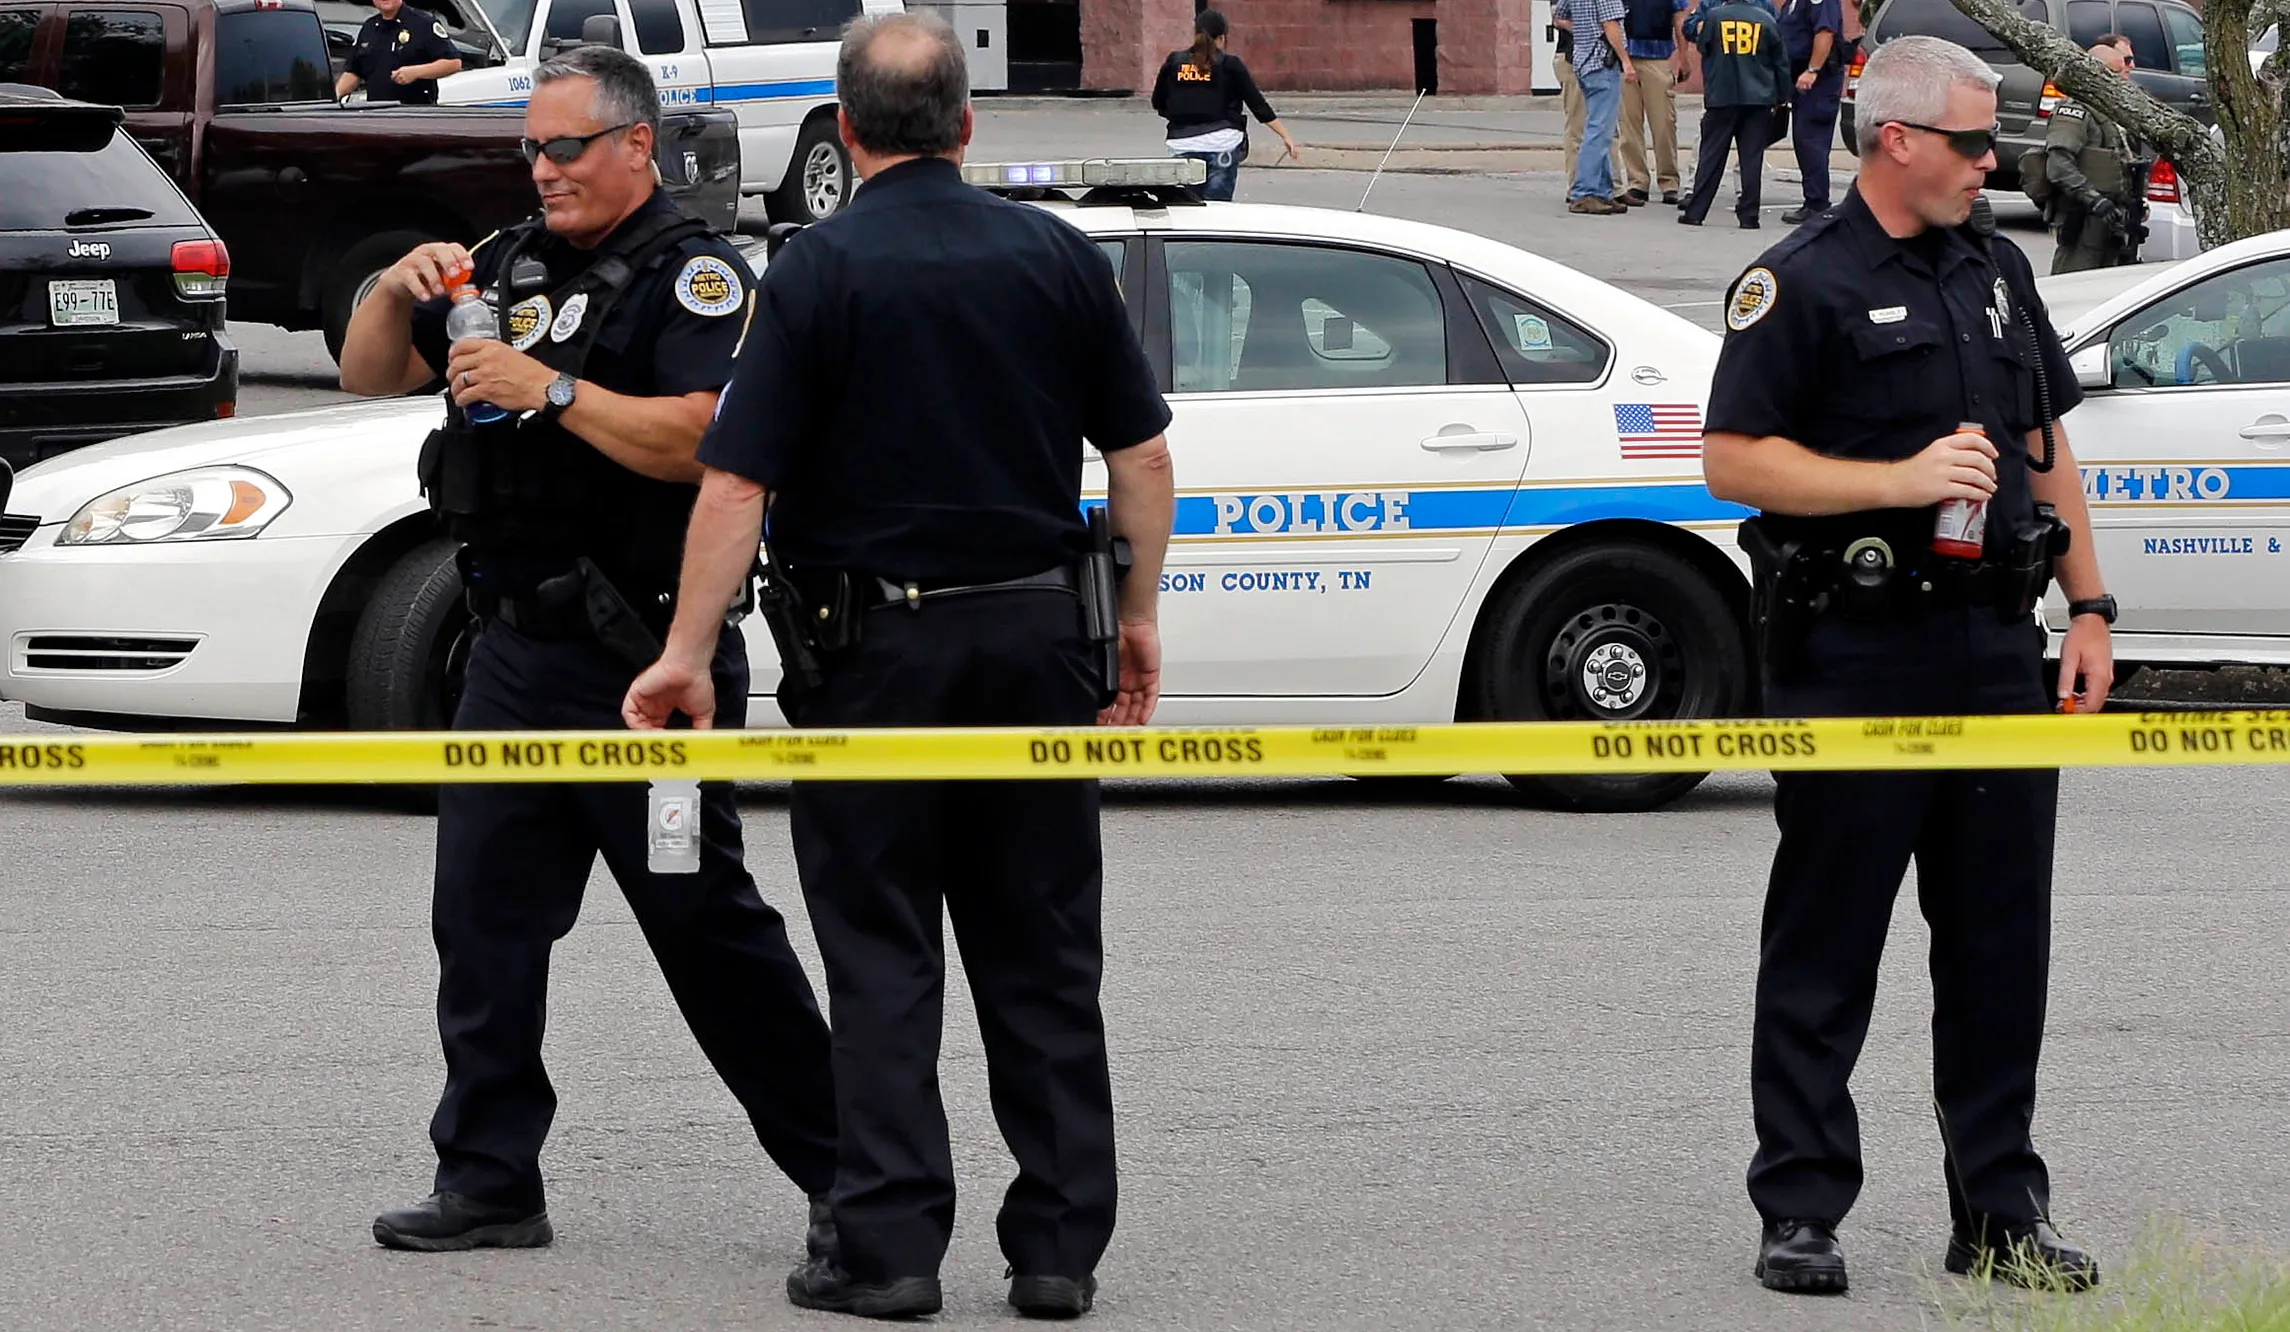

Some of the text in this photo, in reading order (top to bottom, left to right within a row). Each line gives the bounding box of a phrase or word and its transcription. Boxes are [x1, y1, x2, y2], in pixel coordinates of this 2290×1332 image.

[1720, 20, 1763, 55] FBI
[508, 76, 531, 91] 1062
[660, 65, 678, 79] K-9
[1177, 72, 1211, 81] POLICE
[658, 88, 697, 106] OLICE
[2058, 107, 2086, 119] POLICE
[68, 239, 111, 261] Jeep
[691, 281, 729, 294] POLICE
[2080, 467, 2230, 501] METRO
[1213, 492, 1410, 534] POLICE
[2144, 537, 2281, 554] NASHVILLE &
[1158, 571, 1372, 594] SON COUNTY, TN
[1030, 738, 1264, 763] DO NOT CROSS
[1593, 732, 1816, 758] DO NOT CROSS
[2130, 728, 2290, 752] DO NOT CR
[0, 744, 84, 769] ROSS
[444, 741, 688, 767] DO NOT CROSS
